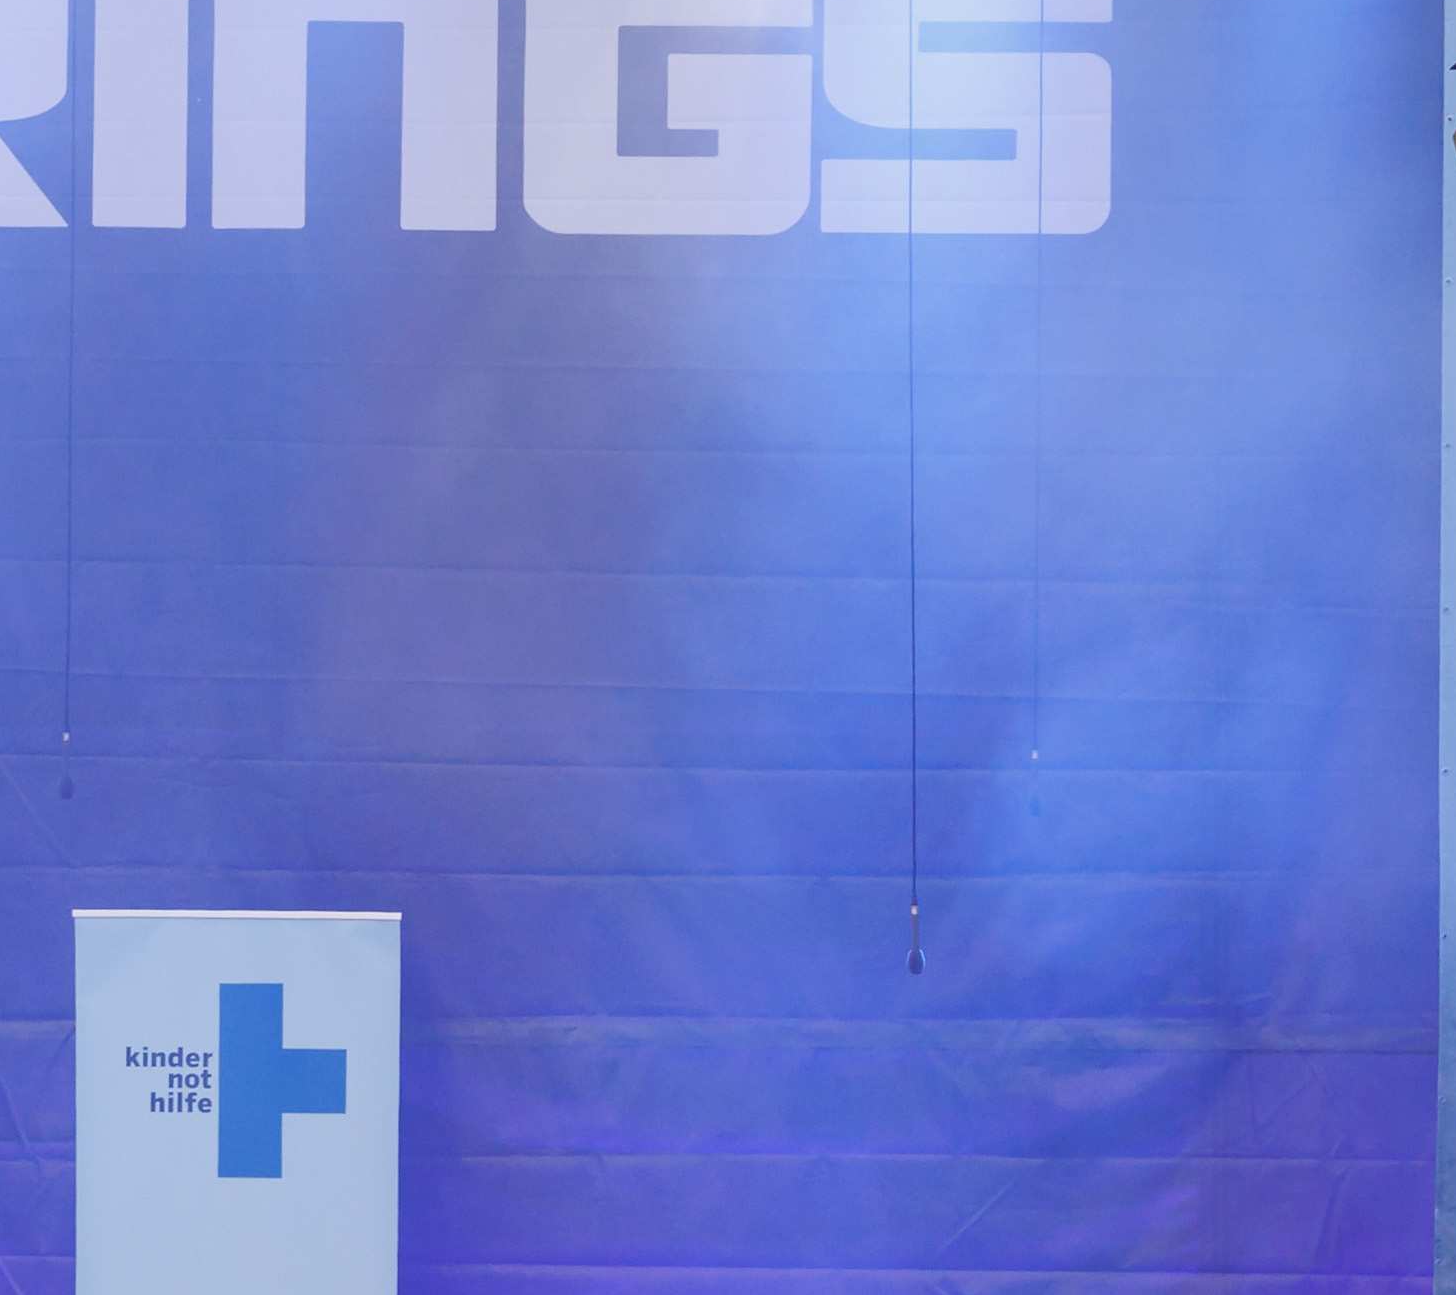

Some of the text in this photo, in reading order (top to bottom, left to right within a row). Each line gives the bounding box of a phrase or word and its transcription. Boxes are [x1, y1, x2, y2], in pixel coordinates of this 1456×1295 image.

[126, 1046, 213, 1067] kinder
[168, 1069, 212, 1089] not
[150, 1091, 212, 1113] hilfe
